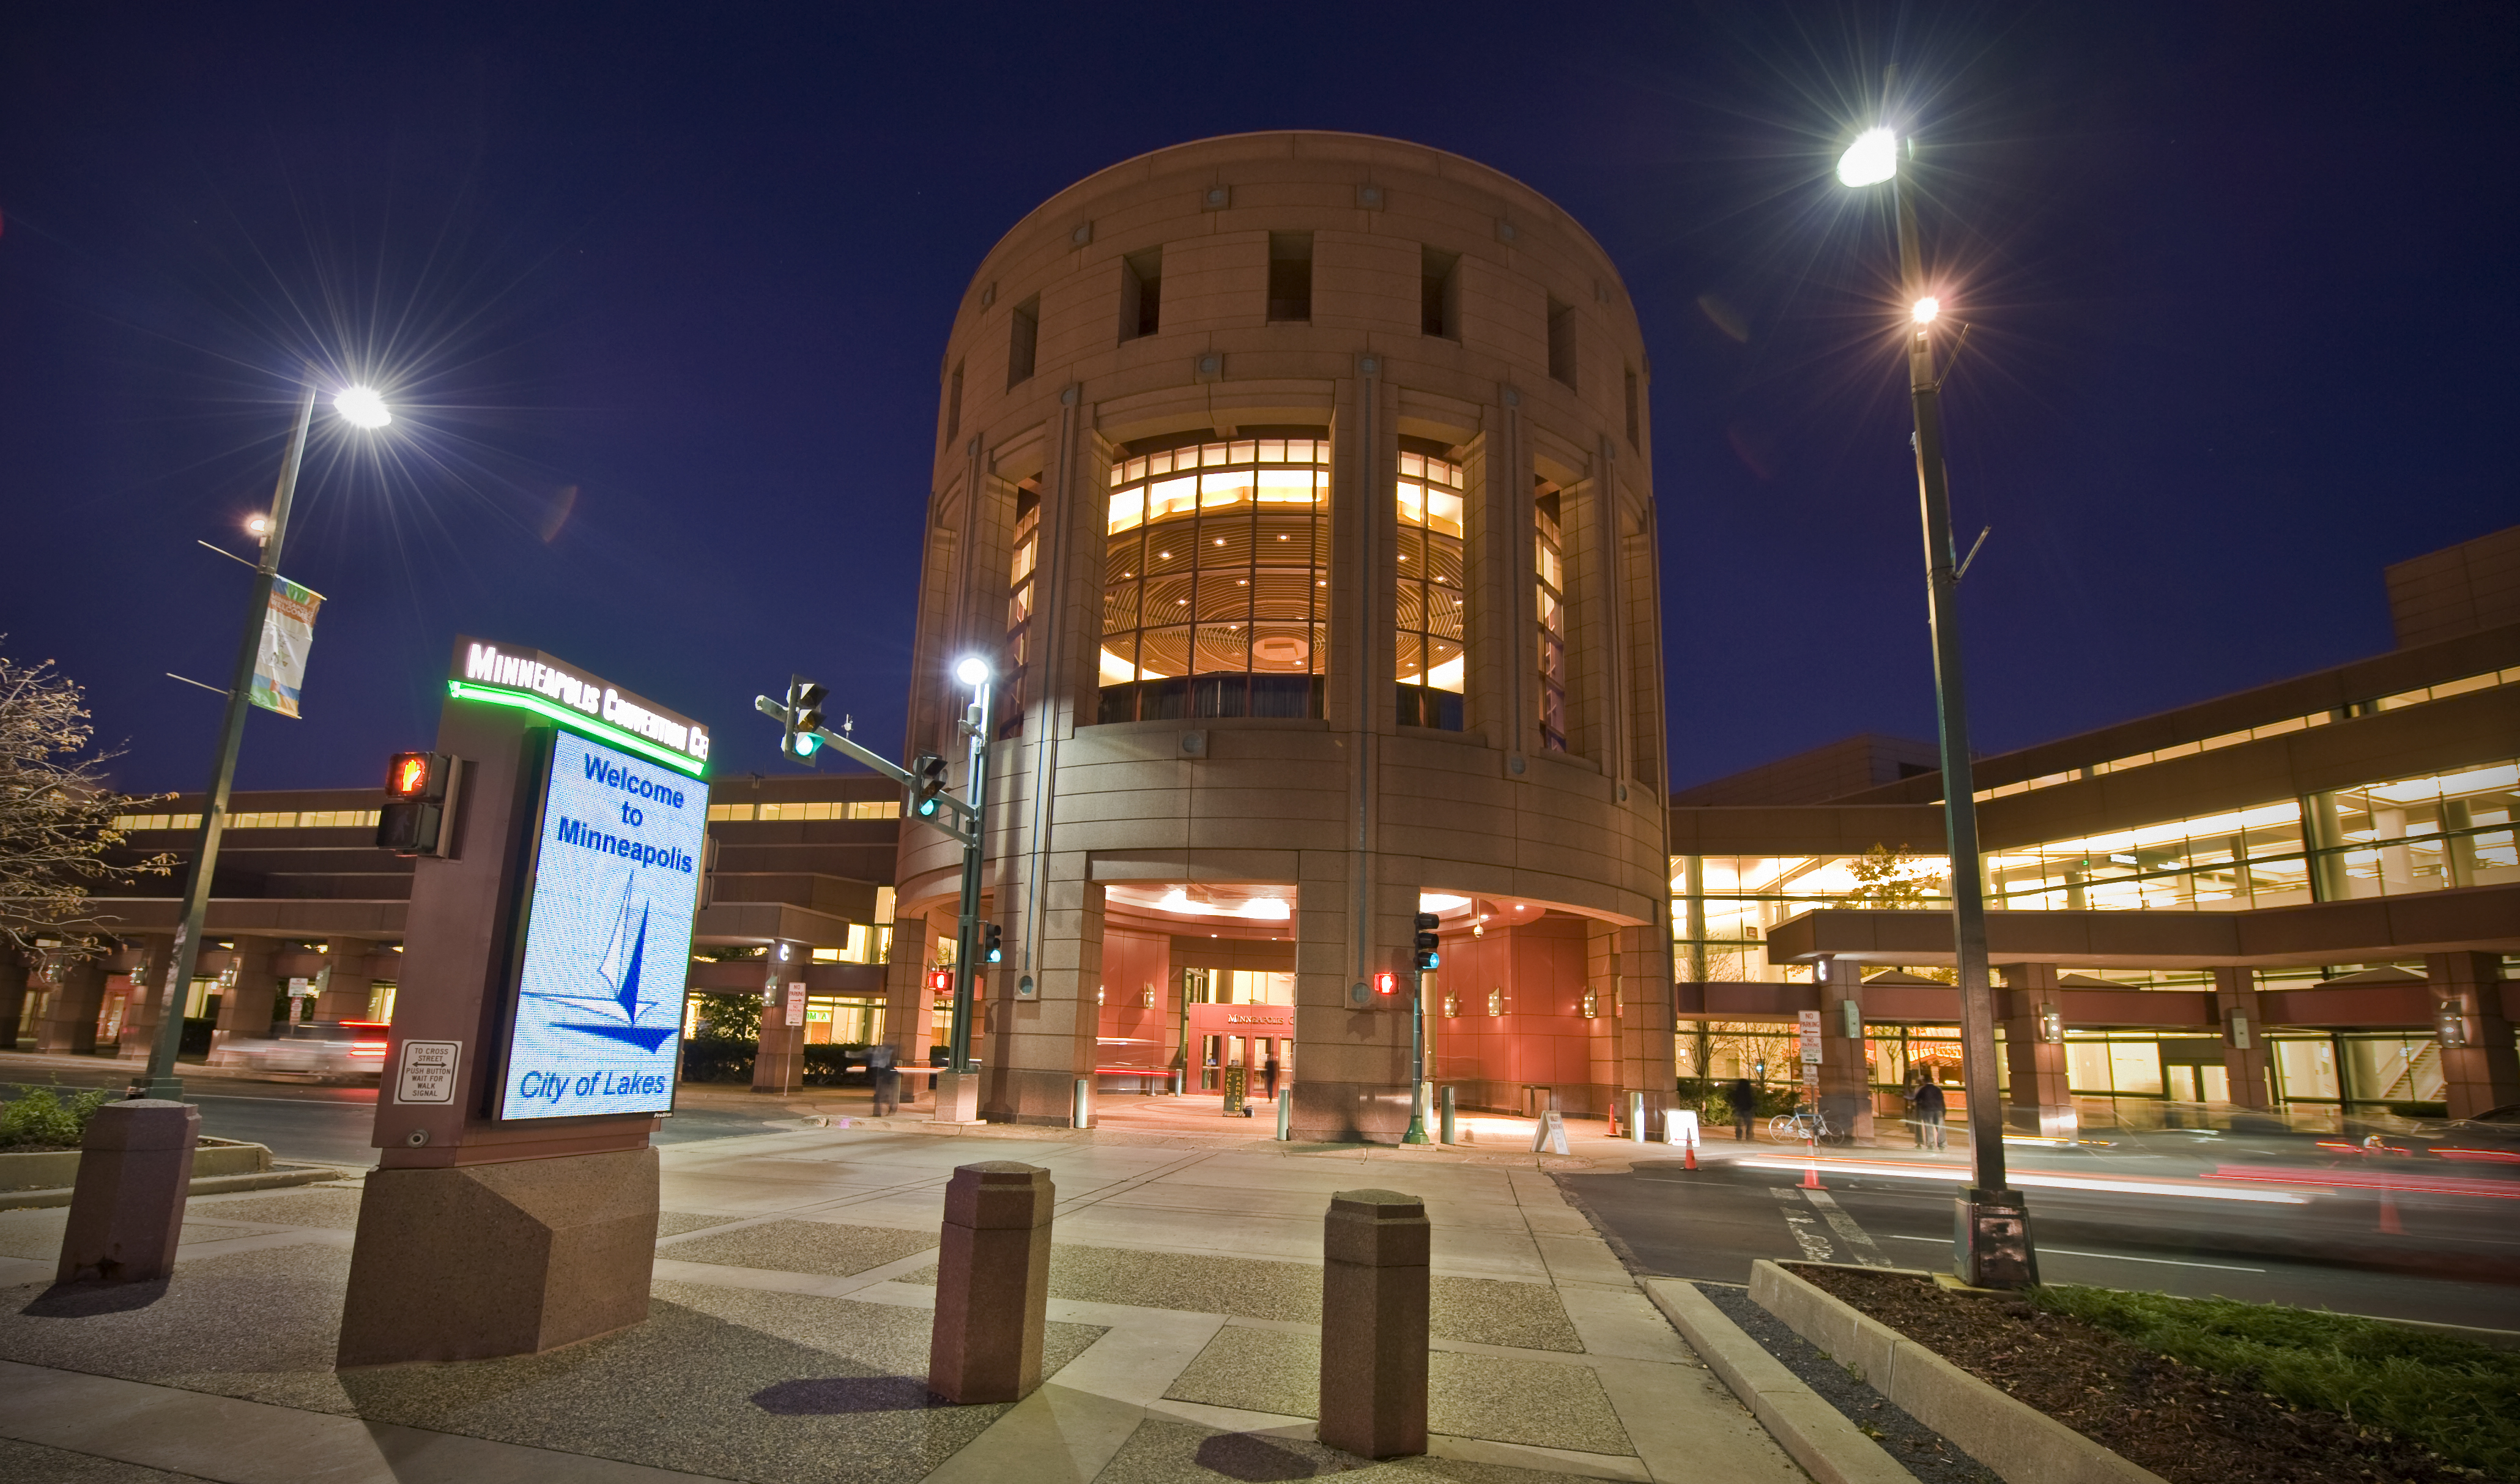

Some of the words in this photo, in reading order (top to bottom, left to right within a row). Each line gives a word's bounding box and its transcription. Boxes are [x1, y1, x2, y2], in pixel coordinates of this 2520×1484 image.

[467, 644, 600, 714] MINNEAPOLIS
[585, 753, 684, 809] Welcome
[622, 801, 643, 827] to
[557, 816, 692, 873] Minneapolis
[1228, 1014, 1284, 1025] MINNEAPOLIS
[521, 1070, 570, 1104] City
[576, 1072, 602, 1096] of
[604, 1070, 665, 1096] Lakes
